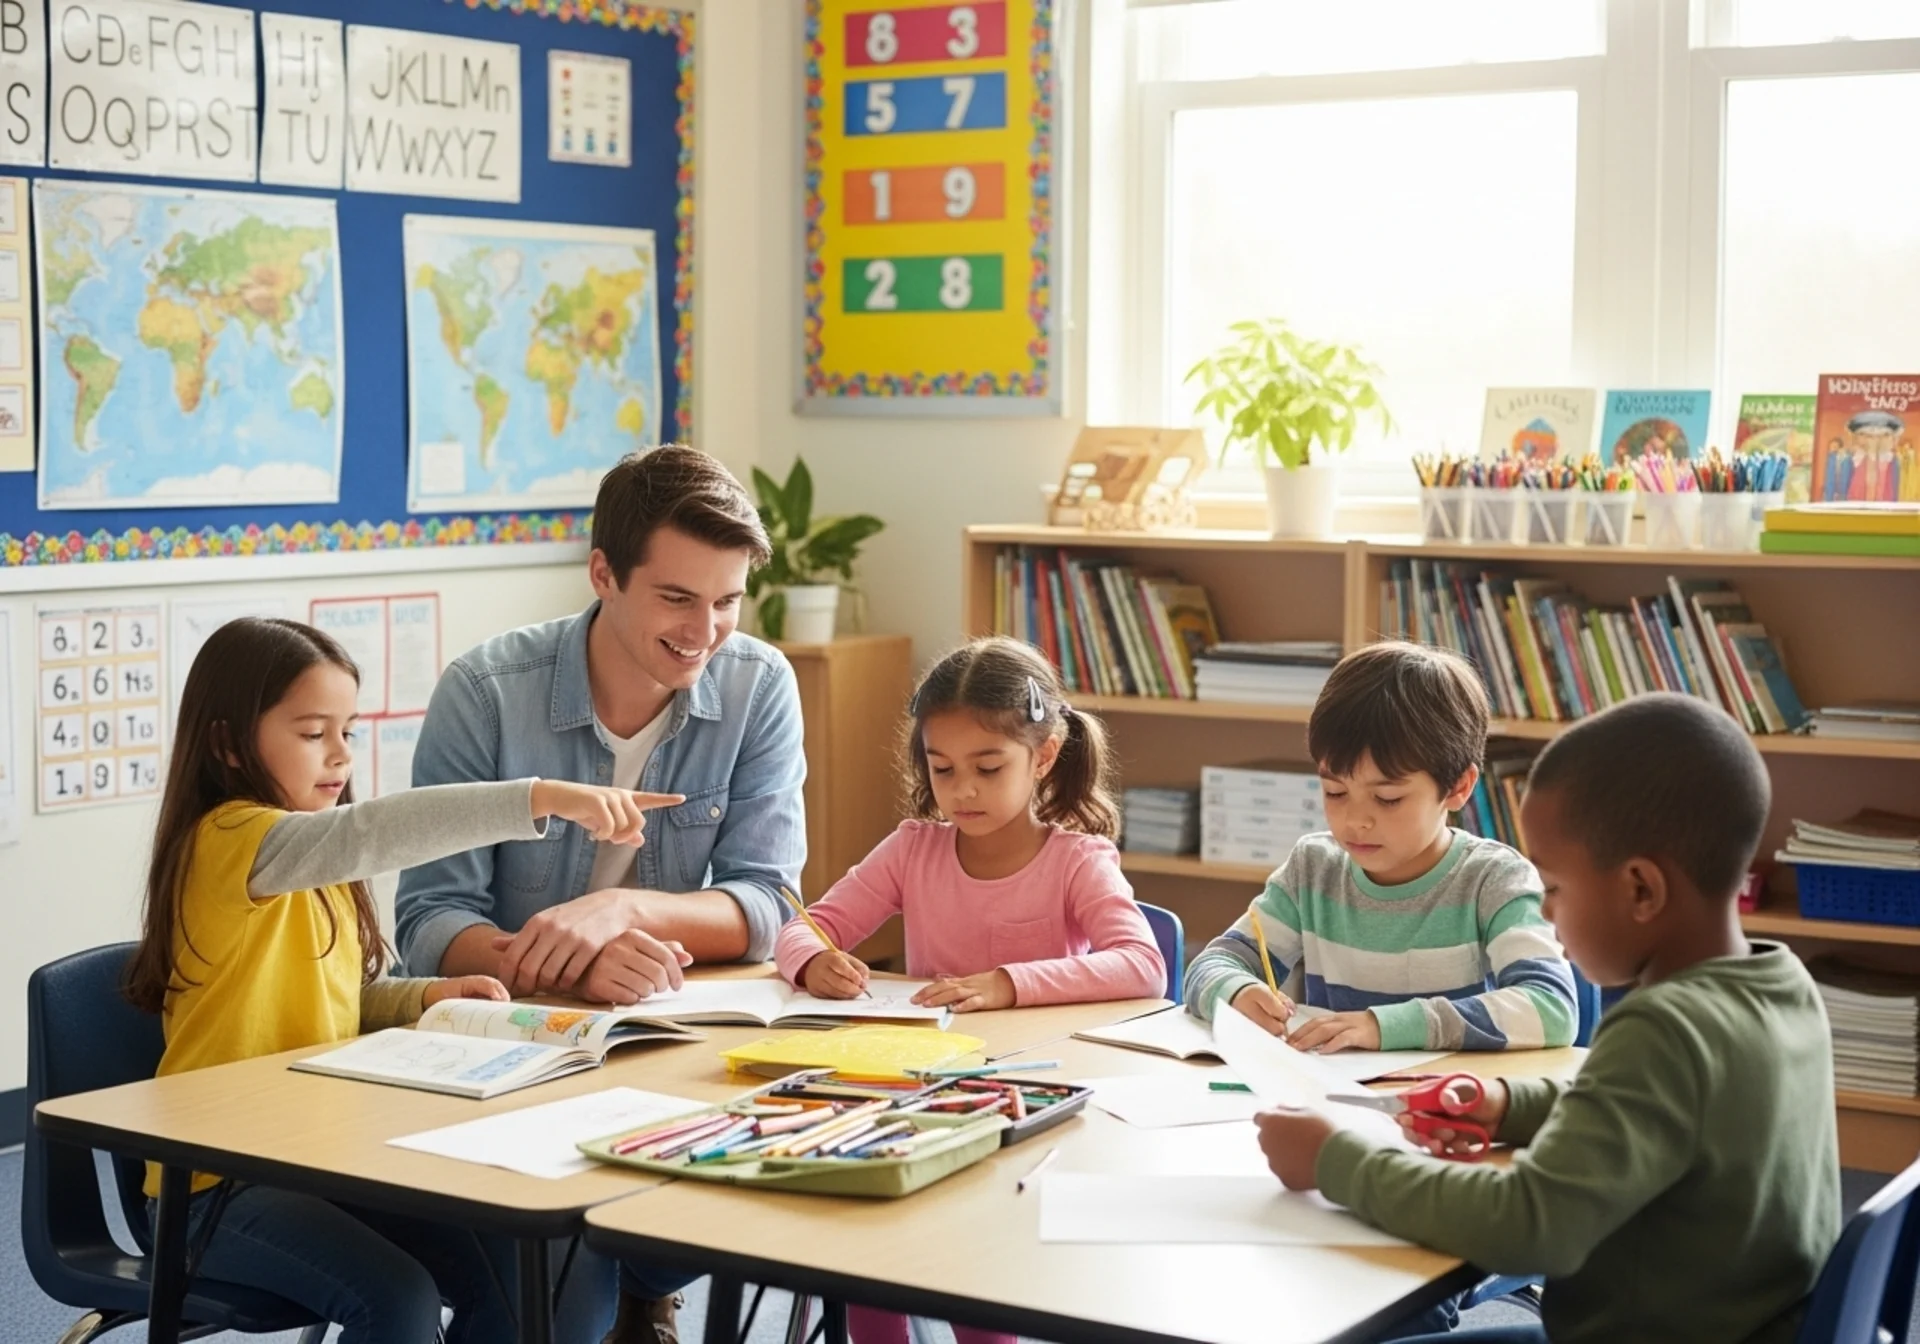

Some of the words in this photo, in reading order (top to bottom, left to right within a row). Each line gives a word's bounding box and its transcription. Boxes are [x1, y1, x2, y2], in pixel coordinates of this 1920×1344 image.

[0, 0, 27, 54] B
[866, 12, 898, 62] 8
[946, 6, 979, 58] 3
[7, 82, 31, 144] S
[865, 82, 896, 132] 5
[942, 77, 975, 128] 7
[870, 171, 891, 220] 1
[943, 166, 975, 217] 9
[864, 259, 898, 309] 2
[939, 257, 971, 309] 8
[92, 621, 108, 649] 2
[93, 666, 108, 696] 6
